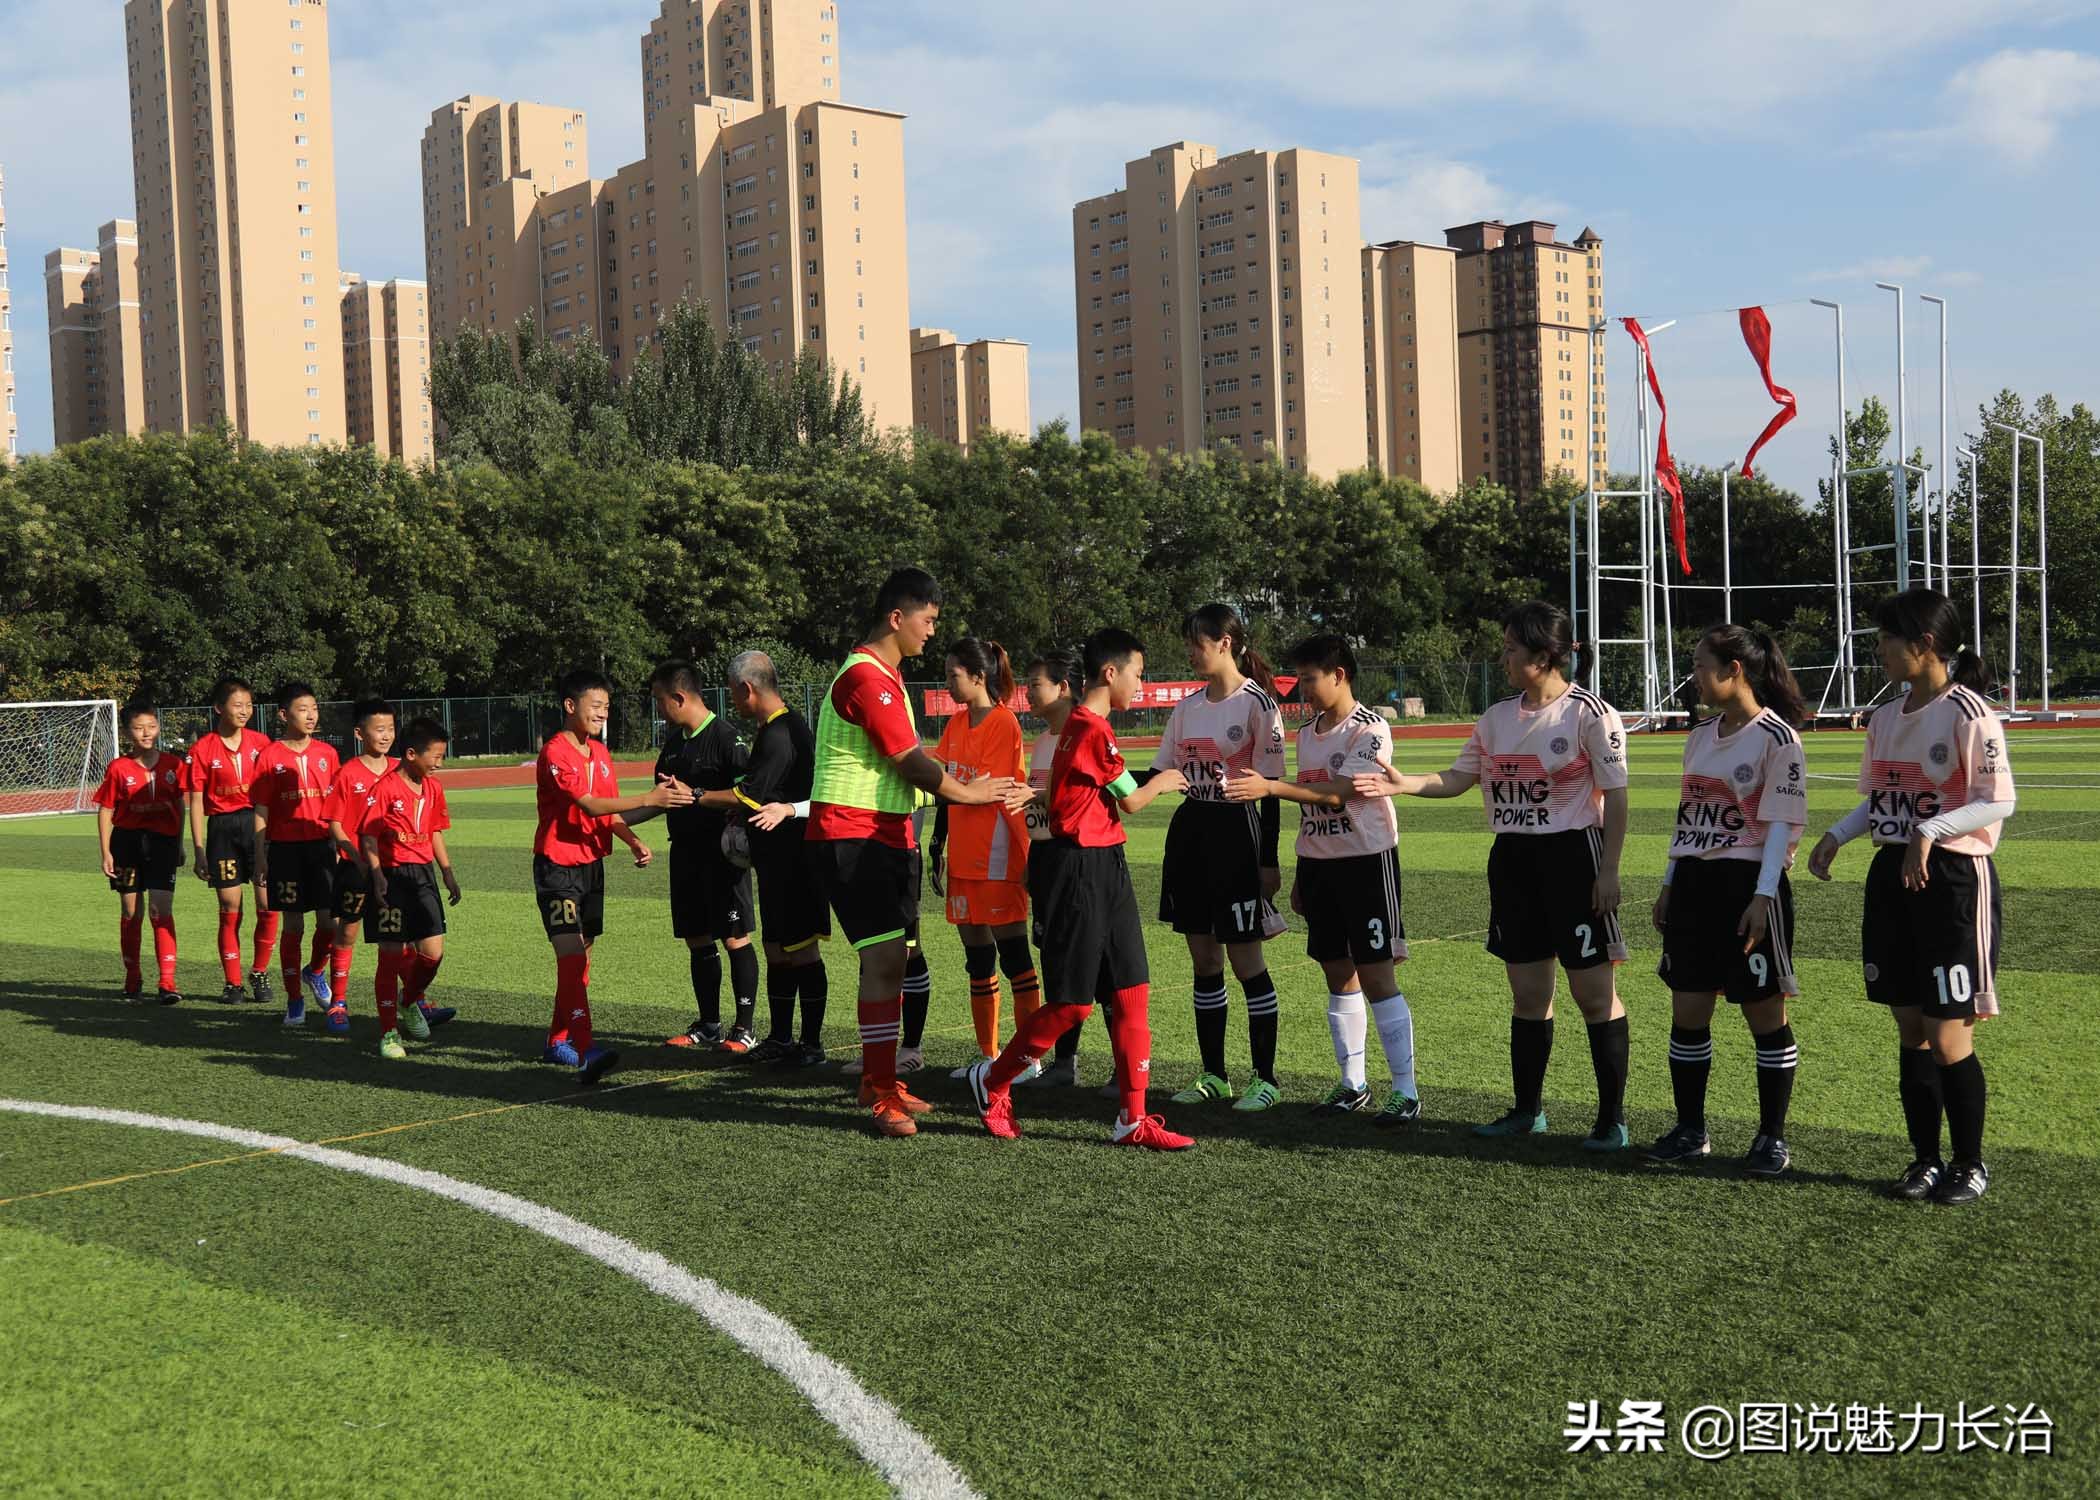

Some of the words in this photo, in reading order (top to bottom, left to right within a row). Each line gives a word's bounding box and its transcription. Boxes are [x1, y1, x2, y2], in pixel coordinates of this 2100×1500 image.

[1491, 779, 1550, 804] KING
[1775, 785, 1805, 799] SAIGON
[1869, 789, 1940, 819] KING
[1493, 807, 1551, 826] POWER
[1677, 801, 1745, 831] KING
[1870, 818, 1919, 837] POW
[218, 858, 238, 881] 15
[276, 881, 297, 904] 25
[343, 892, 366, 915] 27
[377, 907, 402, 933] 29
[549, 899, 577, 926] 28
[1231, 900, 1257, 932] 17
[1368, 917, 1385, 950] 3
[1575, 923, 1597, 958] 2
[1748, 953, 1769, 988] 9
[1932, 963, 1972, 1005] 10
